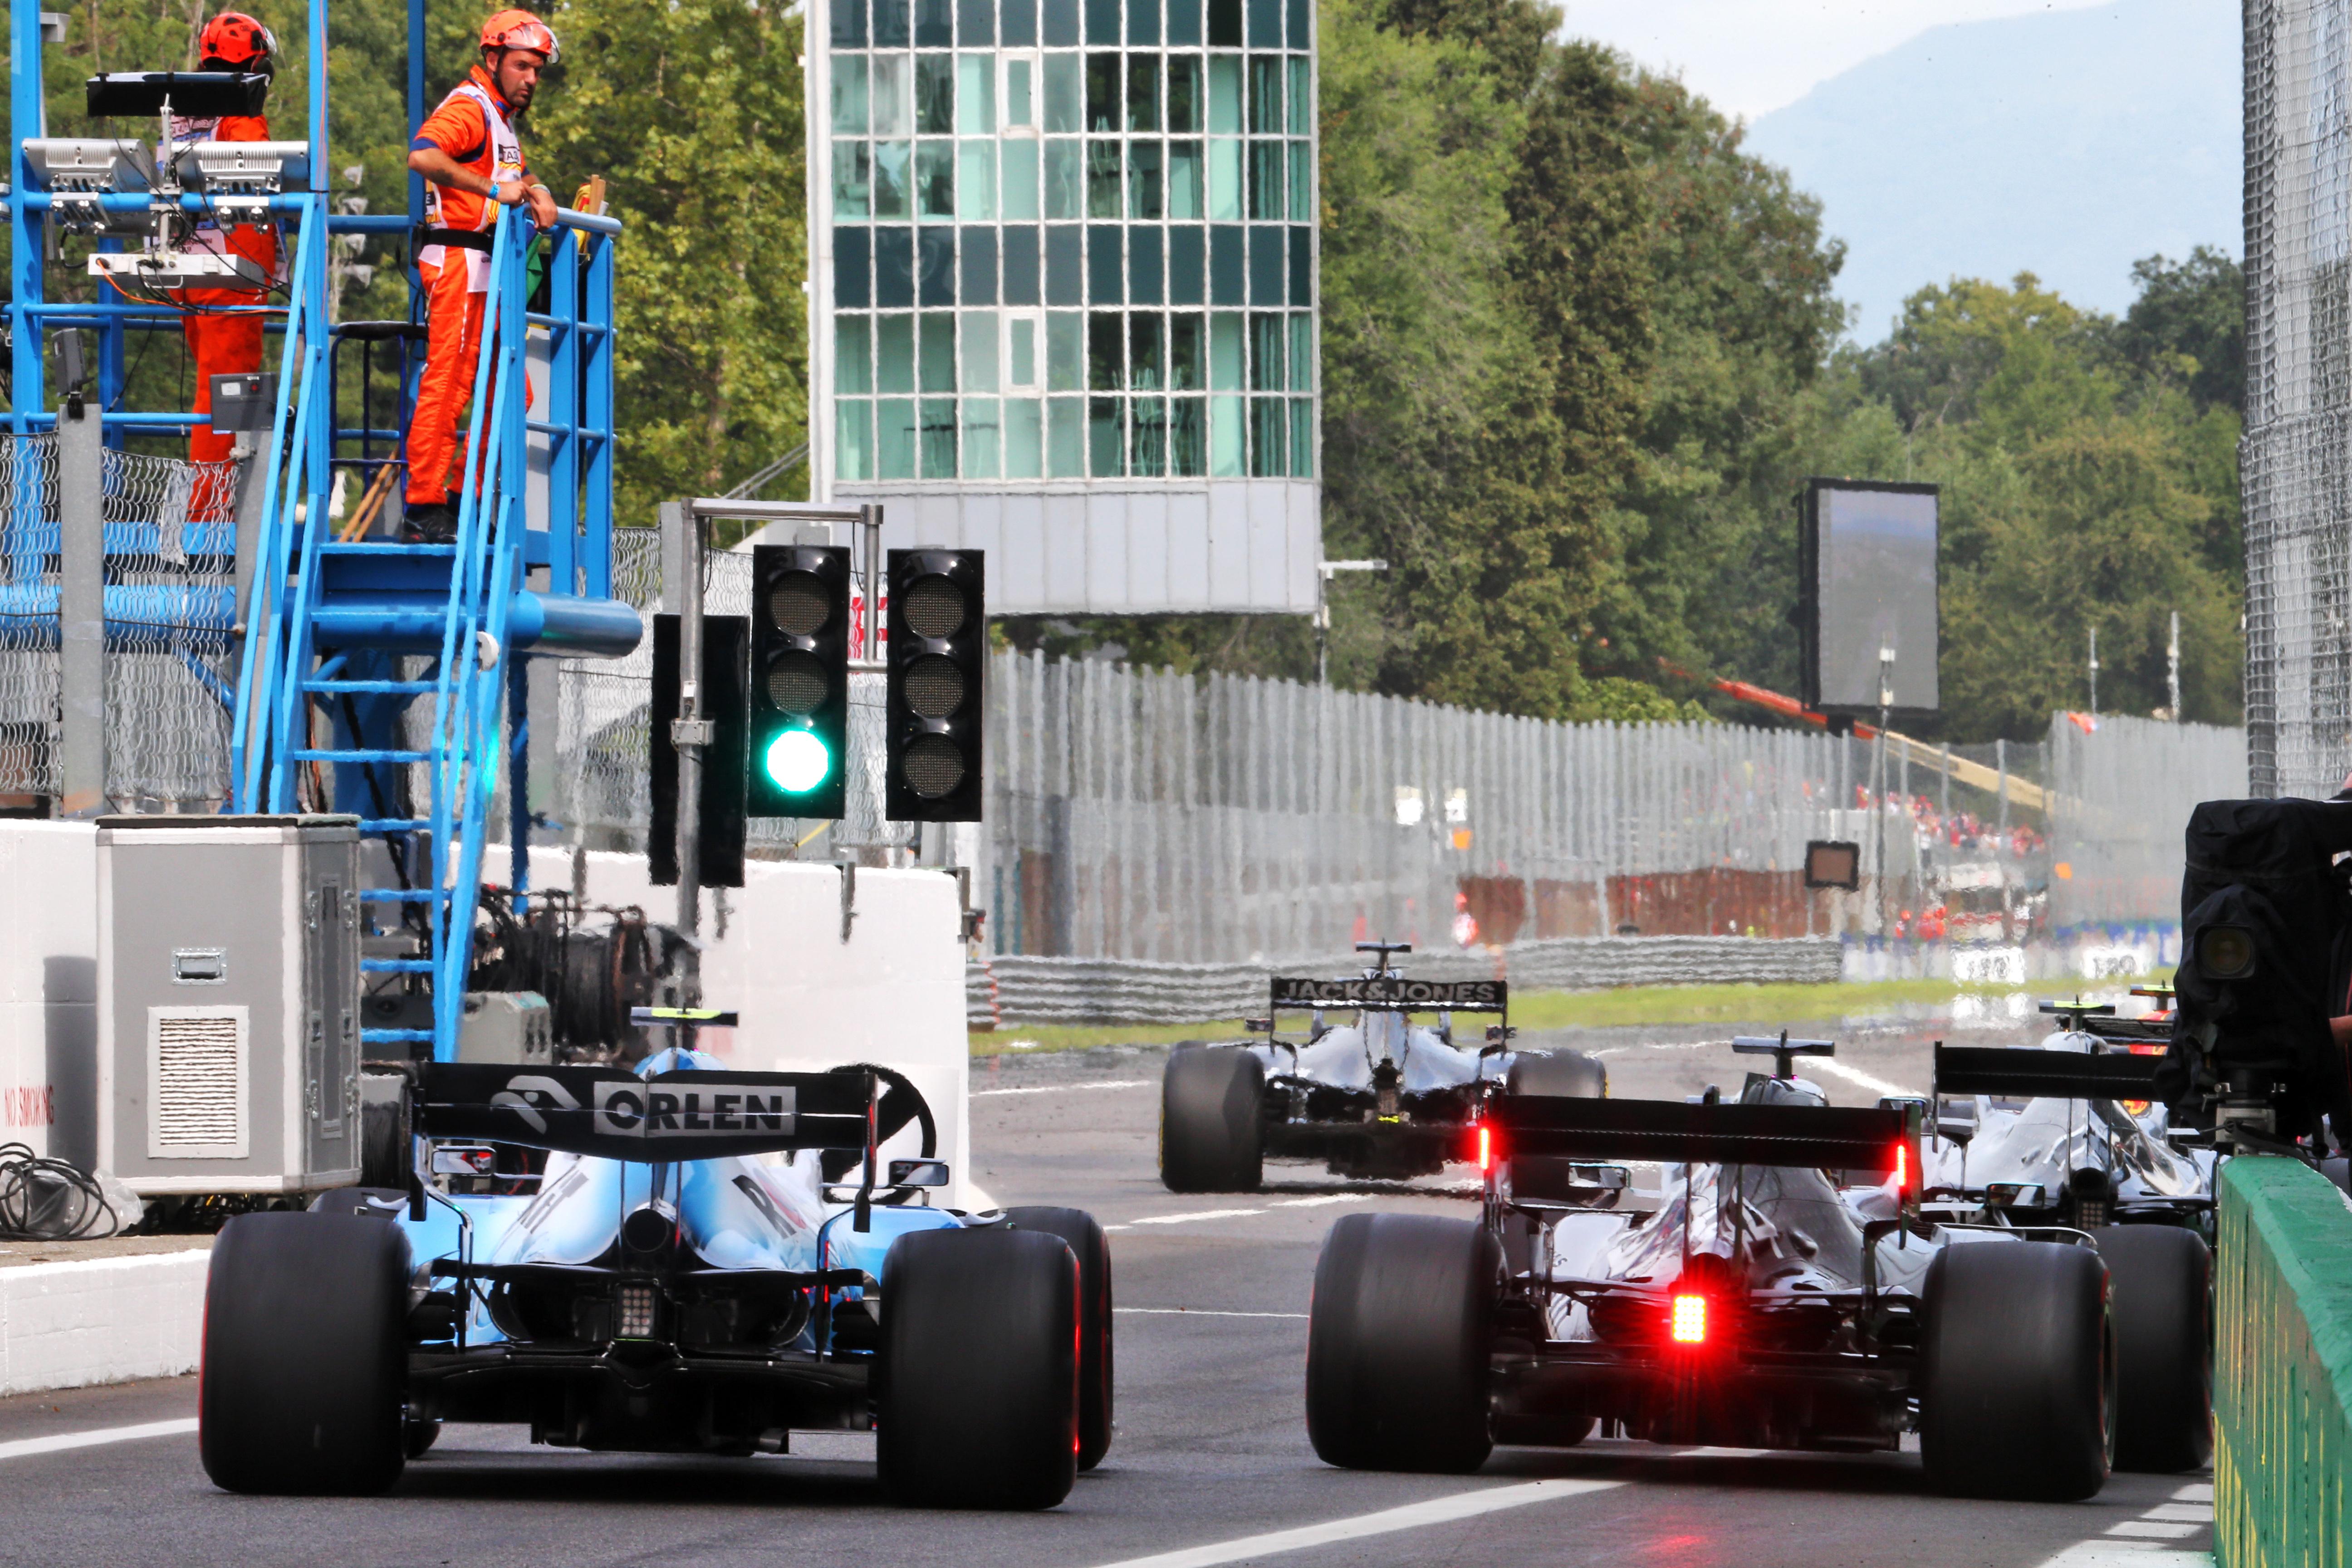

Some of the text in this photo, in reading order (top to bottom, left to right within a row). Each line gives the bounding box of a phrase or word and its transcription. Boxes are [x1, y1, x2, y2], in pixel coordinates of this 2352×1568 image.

[5, 1085, 54, 1127] NO SMOKING
[605, 1090, 782, 1130] ORLEN
